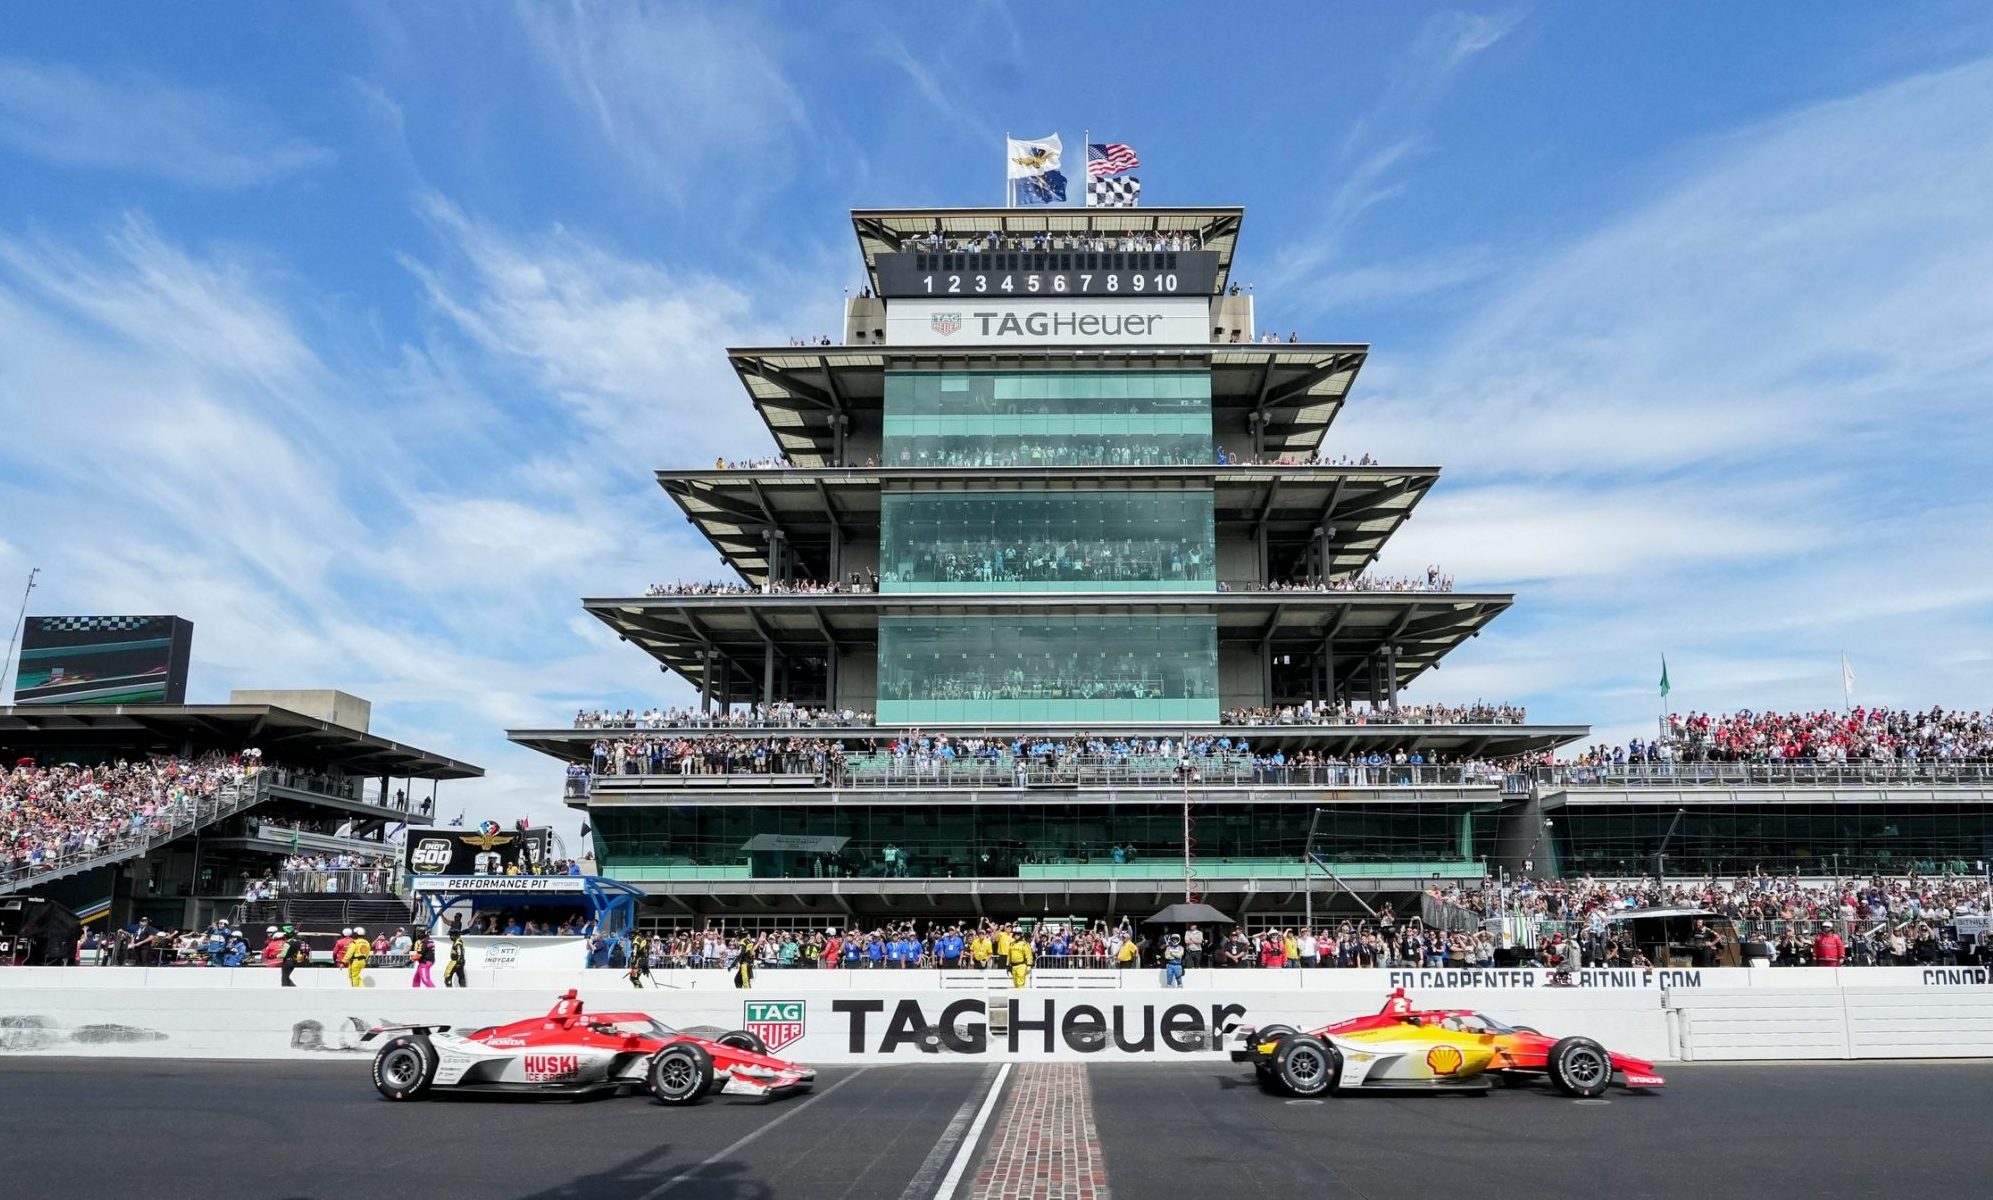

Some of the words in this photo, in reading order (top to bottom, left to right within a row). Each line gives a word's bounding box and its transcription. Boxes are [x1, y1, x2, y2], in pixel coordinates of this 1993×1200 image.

[923, 275, 932, 292] 1
[948, 275, 961, 292] 2
[975, 275, 987, 292] 3
[1001, 275, 1013, 292] 4
[1028, 275, 1039, 292] 5
[1054, 275, 1065, 292] 6
[1080, 275, 1092, 292] 7
[1107, 275, 1119, 292] 8
[1133, 275, 1144, 292] 9
[1154, 275, 1178, 292] 10
[413, 850, 448, 863] 500
[448, 880, 528, 888] PERFORMANCE
[530, 880, 549, 888] PIT
[558, 1000, 569, 1014] 8
[1394, 998, 1406, 1012] 2
[750, 1005, 799, 1020] TAG
[832, 999, 986, 1054] TAG
[1008, 999, 1247, 1054] Heuer
[486, 1038, 526, 1046] HONDA
[750, 1024, 800, 1046] HEUER
[524, 1056, 578, 1073] HUSKI
[526, 1074, 540, 1082] ICE
[542, 1072, 578, 1082] SPRITZ
